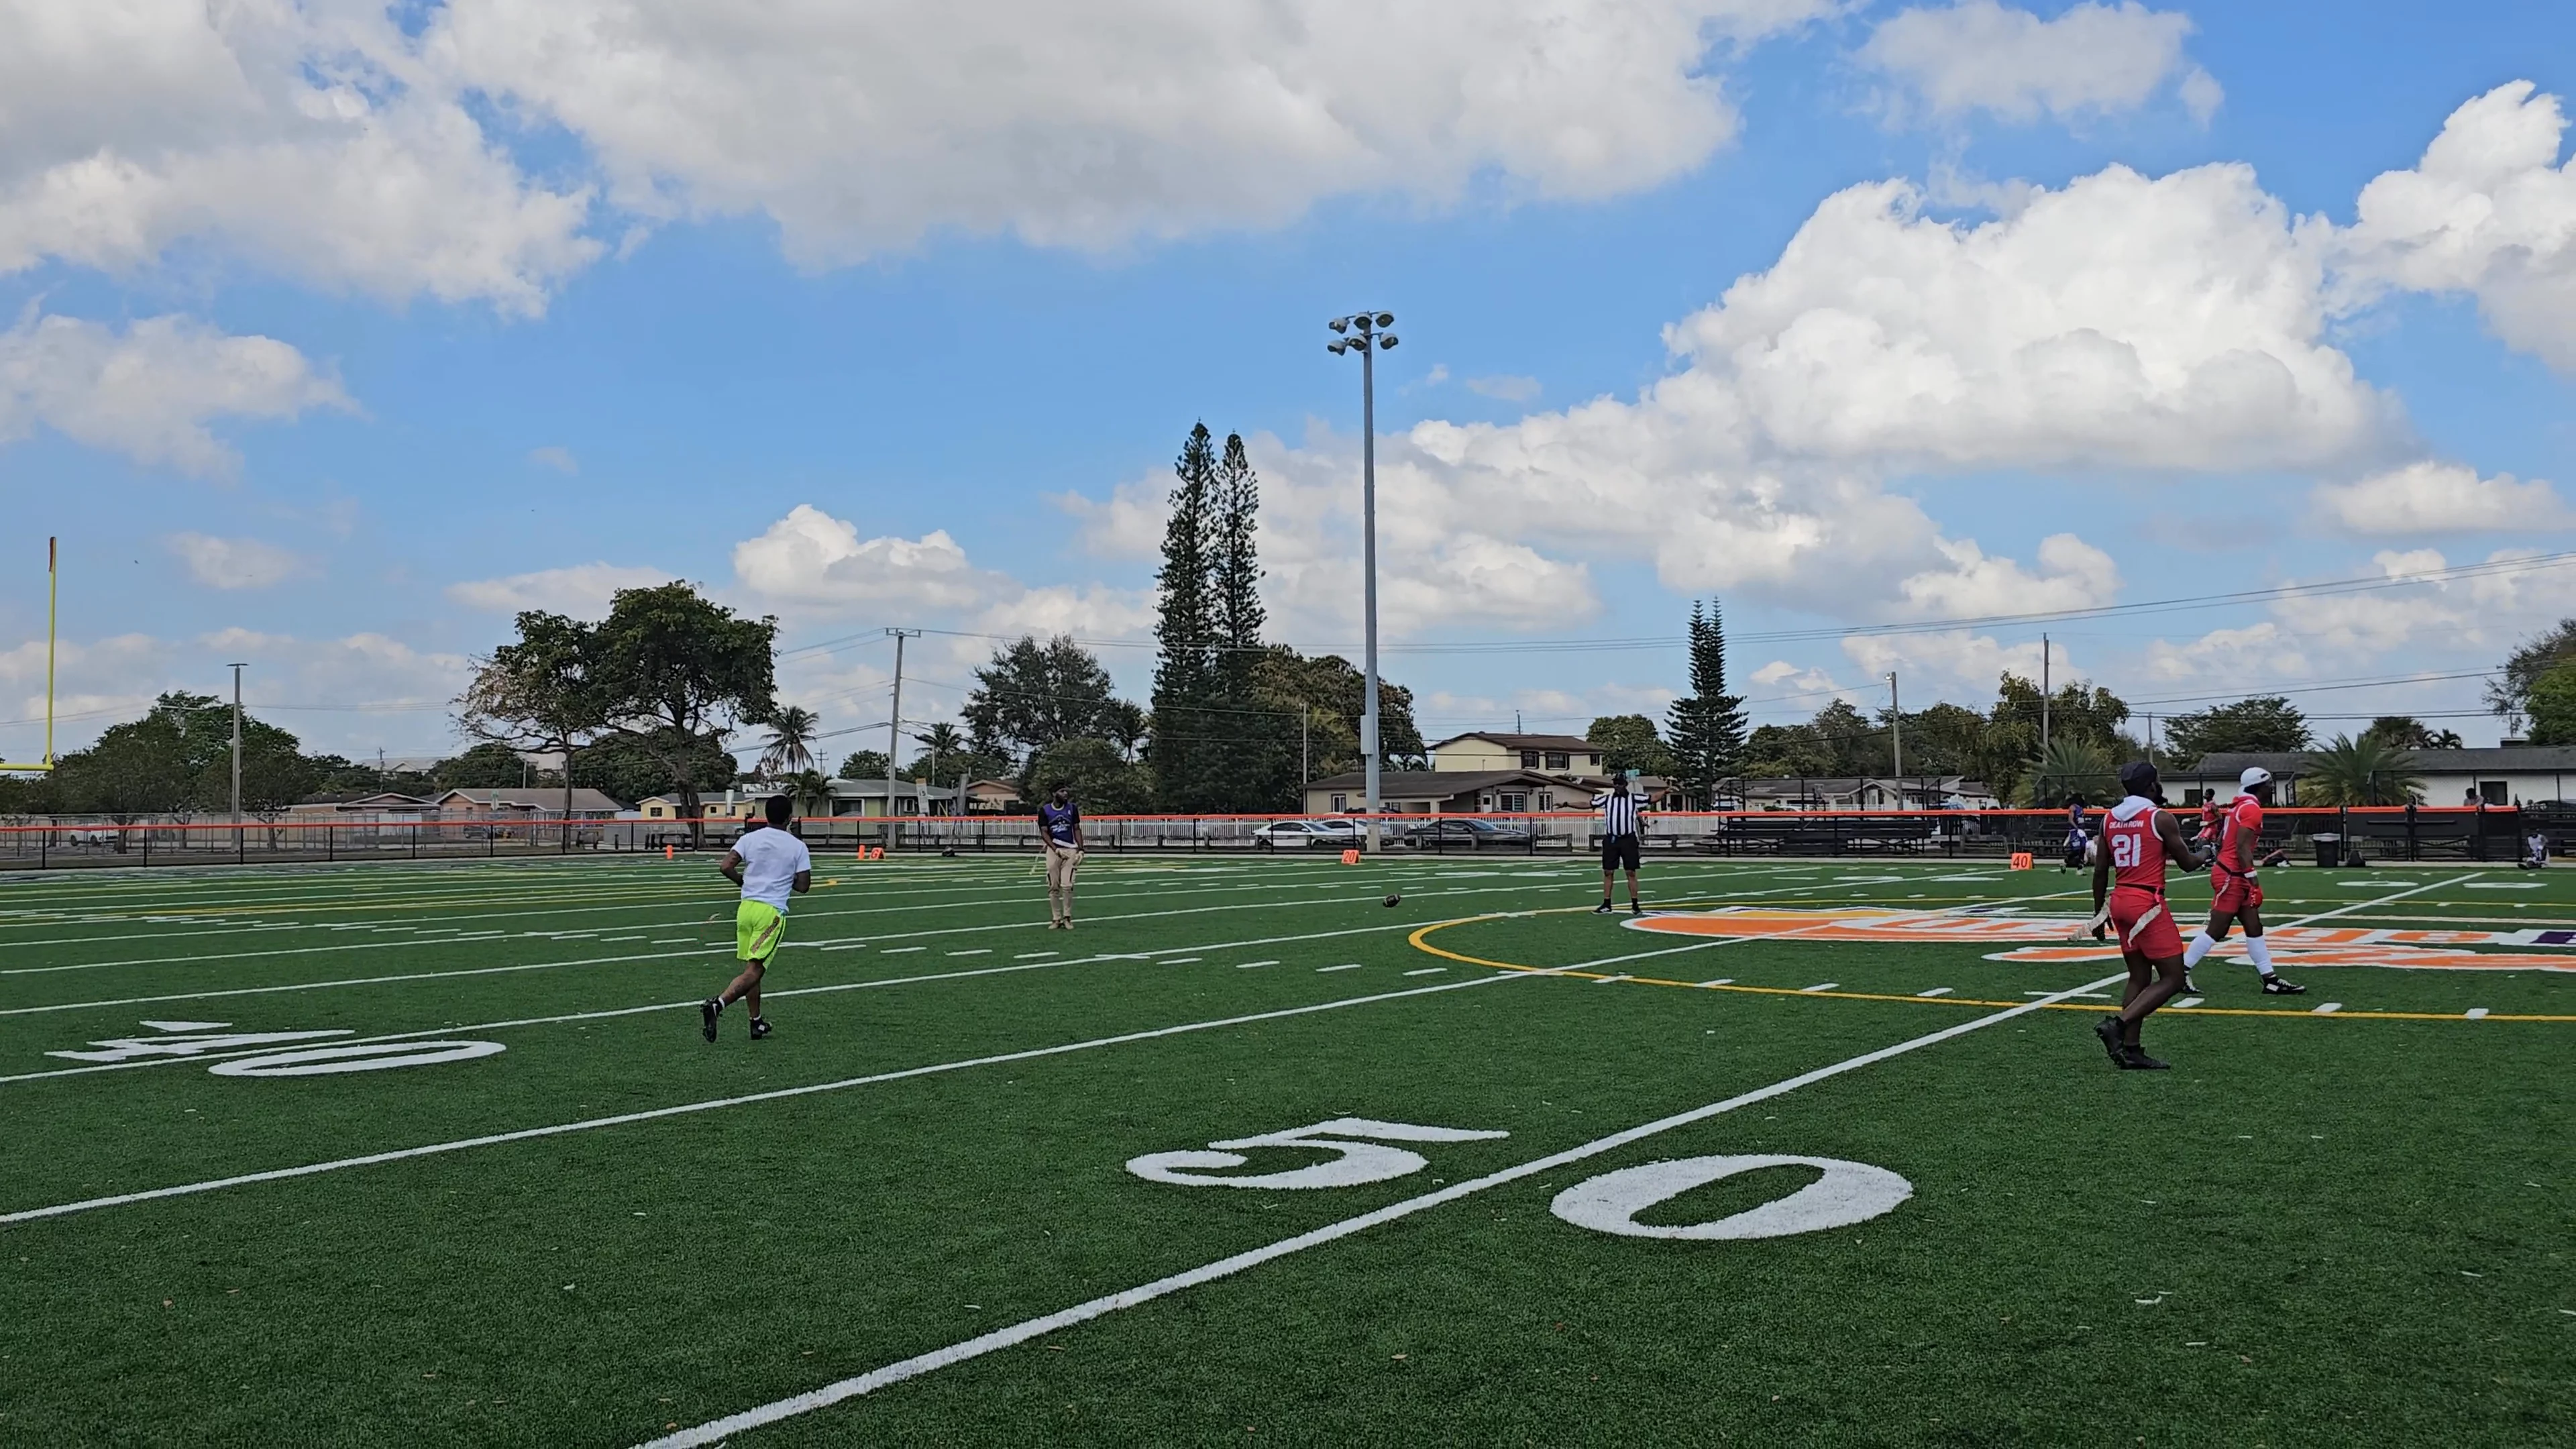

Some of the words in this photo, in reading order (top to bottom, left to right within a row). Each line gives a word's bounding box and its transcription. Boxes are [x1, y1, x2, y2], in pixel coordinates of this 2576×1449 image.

[2128, 820, 2144, 828] ROW
[871, 849, 879, 859] G
[2111, 833, 2141, 867] 21
[1343, 851, 1356, 863] 20
[2012, 855, 2028, 868] 40
[42, 1029, 507, 1077] 40
[1125, 1117, 1914, 1240] 50
